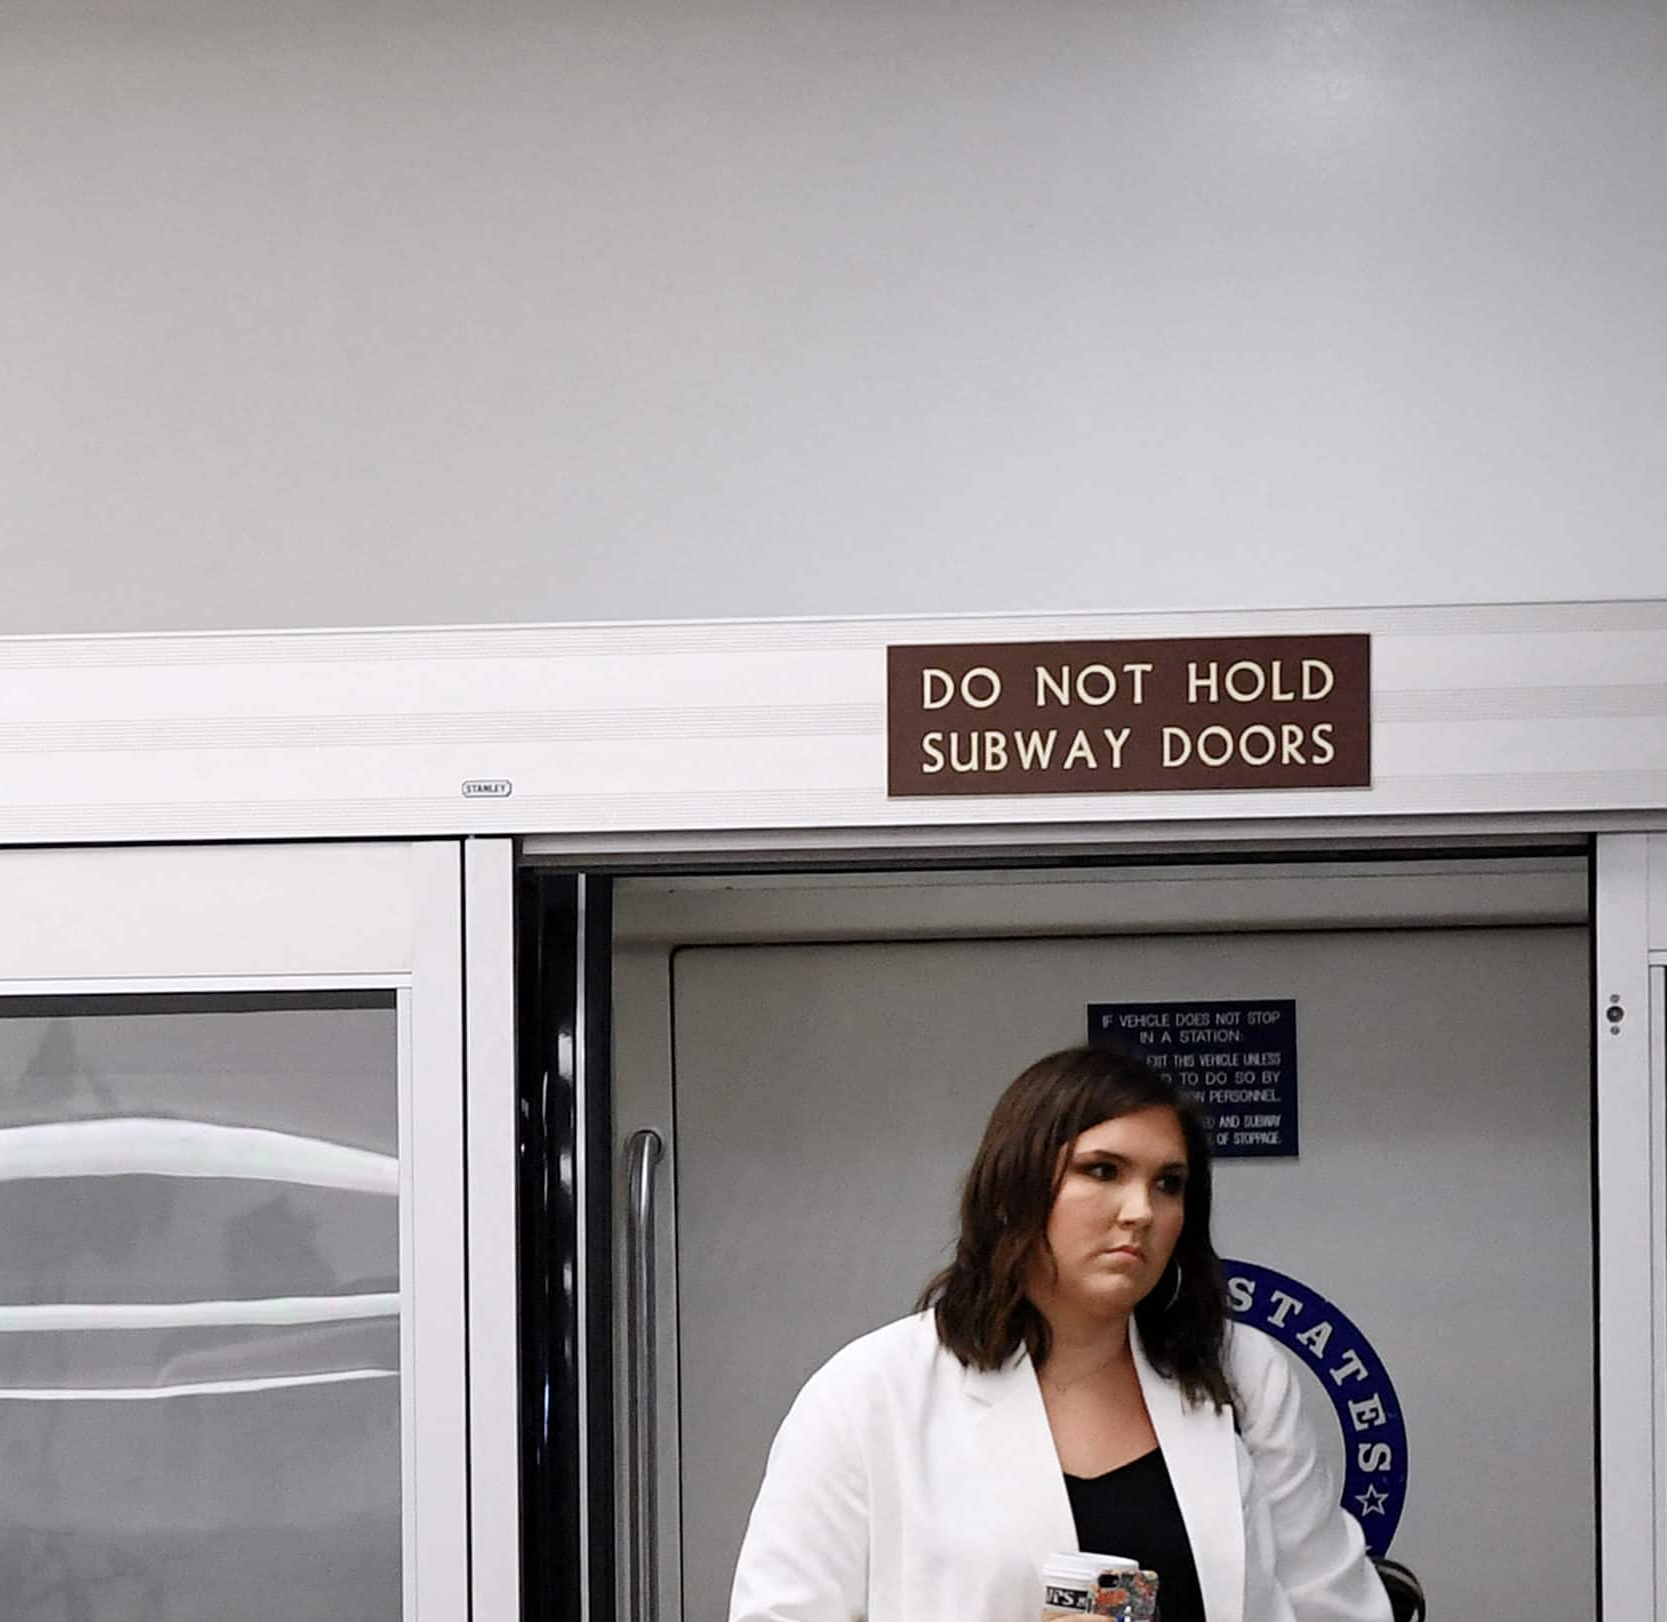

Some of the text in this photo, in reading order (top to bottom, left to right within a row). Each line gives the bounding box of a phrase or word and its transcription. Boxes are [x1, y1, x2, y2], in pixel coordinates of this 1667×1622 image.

[922, 659, 1334, 709] DO NOT HOLD
[922, 723, 1334, 773] SUBWAY DOORS
[1102, 1011, 1280, 1029] IF VEHICLE DOES NOT STOP
[1139, 1032, 1154, 1044] IN
[1161, 1031, 1172, 1043] A
[1175, 1054, 1194, 1067] THIS
[1200, 1053, 1239, 1067] VEHICLE
[1244, 1052, 1281, 1066] UNLESS
[1180, 1072, 1199, 1085] TO
[1205, 1072, 1227, 1085] DO
[1235, 1071, 1255, 1084] SO
[1262, 1071, 1281, 1083] BY
[1219, 1115, 1240, 1128] AND
[1244, 1115, 1281, 1127] SUBWAY
[1217, 1132, 1229, 1145] OF
[1227, 1277, 1391, 1472] STATES
